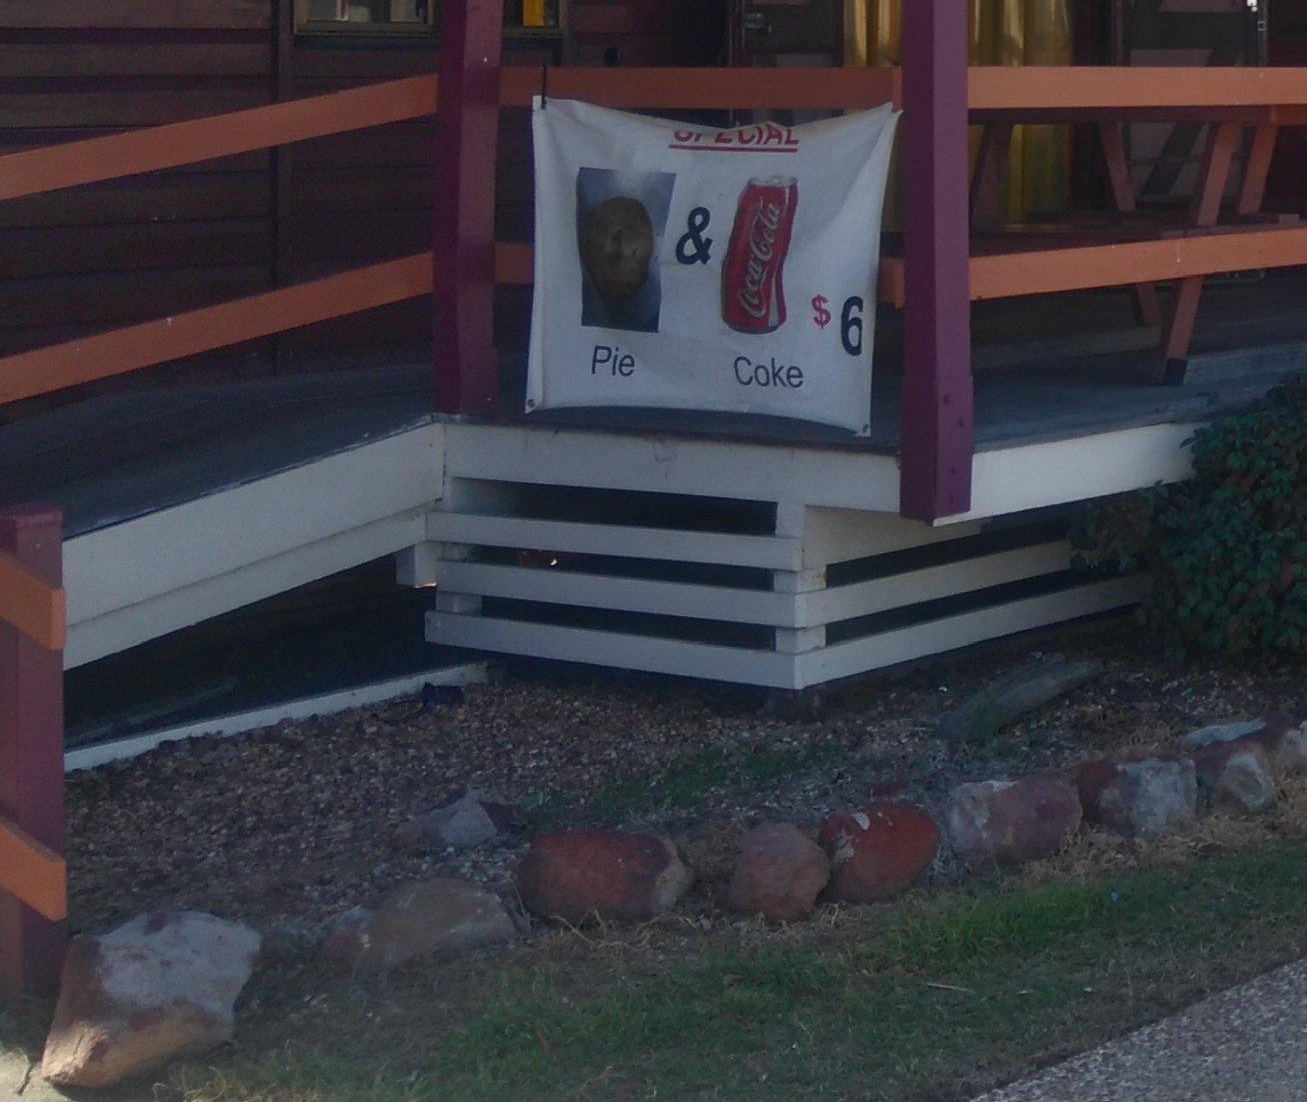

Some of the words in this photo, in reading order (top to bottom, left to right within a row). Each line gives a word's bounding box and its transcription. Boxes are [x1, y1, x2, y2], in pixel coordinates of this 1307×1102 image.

[675, 207, 713, 266] &
[591, 345, 636, 377] Pie
[733, 356, 804, 388] Coke
